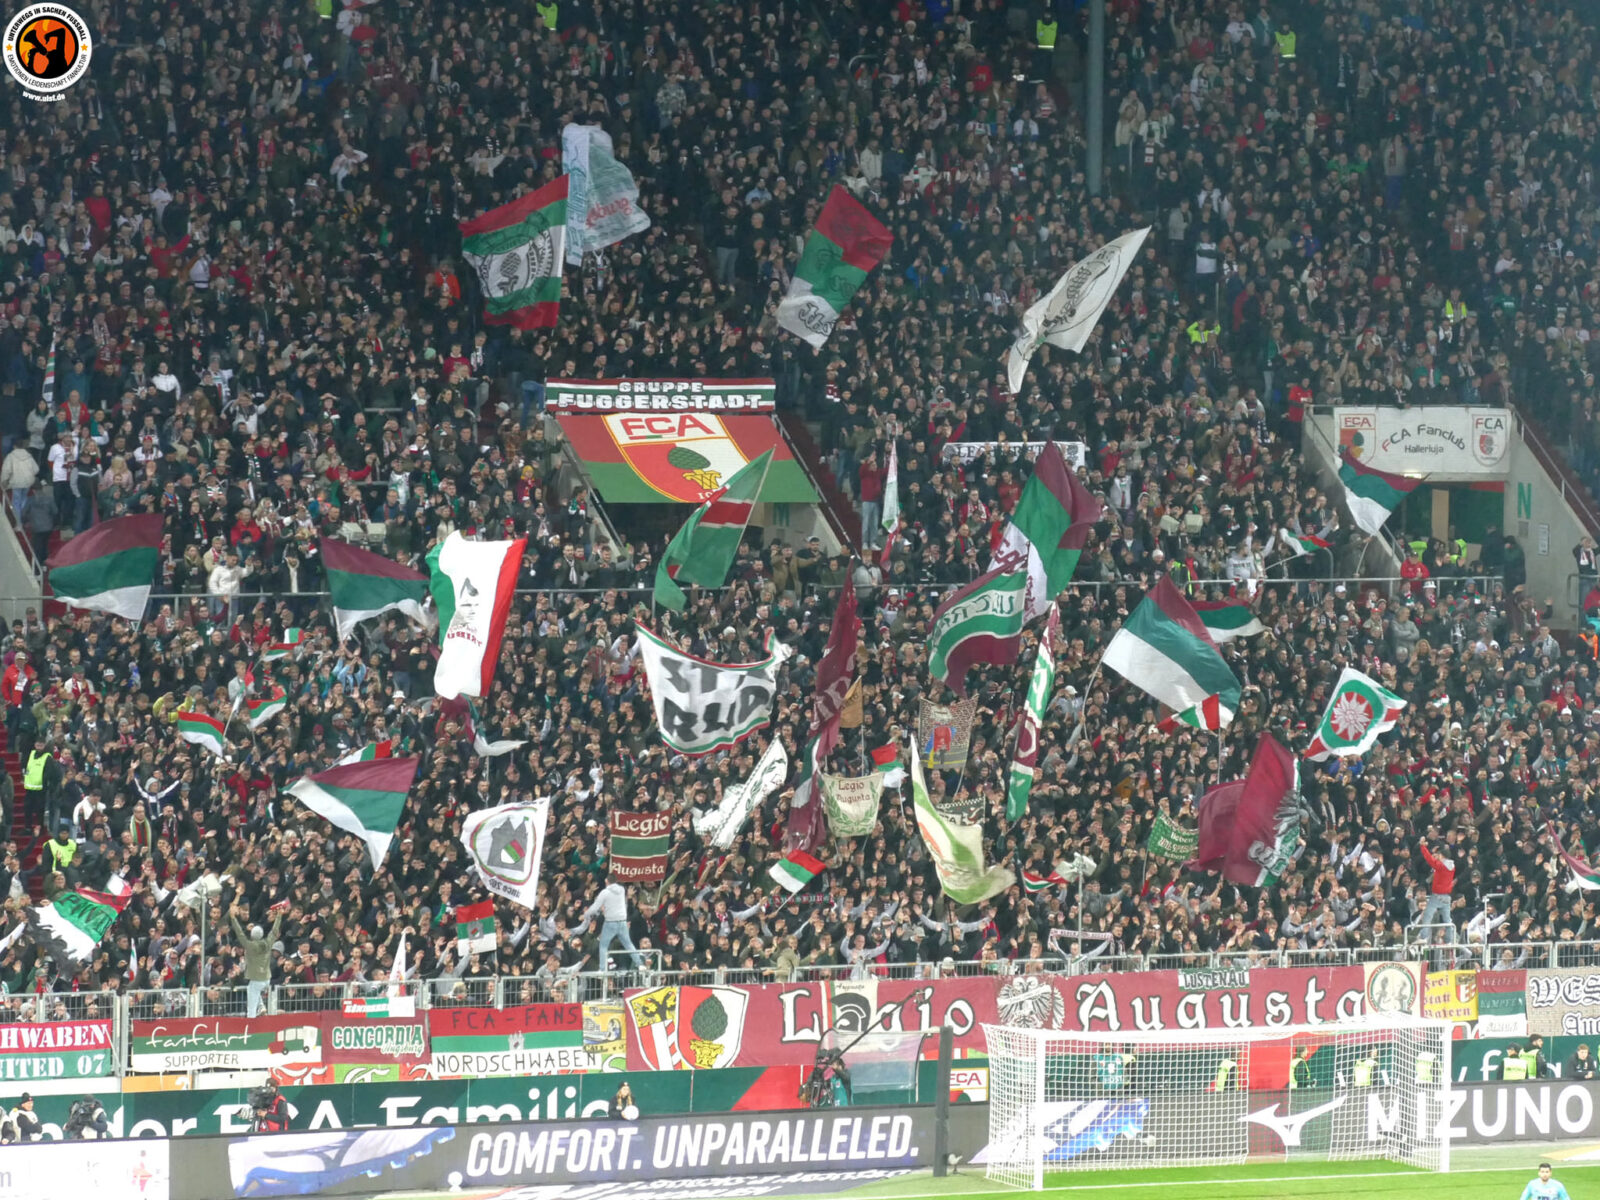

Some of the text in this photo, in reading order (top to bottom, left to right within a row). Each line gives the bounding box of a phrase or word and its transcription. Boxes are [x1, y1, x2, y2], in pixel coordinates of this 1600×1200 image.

[618, 381, 705, 394] GRUPPE
[557, 393, 763, 409] FUGGERSTADT
[620, 414, 716, 438] FCA
[1344, 416, 1372, 428] FCA
[1475, 417, 1504, 430] FCA
[1382, 424, 1466, 453] FCA Fanclub
[1517, 482, 1532, 520] N
[838, 778, 866, 794] Legio
[613, 811, 670, 837] Legio
[611, 862, 665, 878] Augusta
[1183, 968, 1248, 990] LUSTENAU
[452, 1011, 496, 1030] FCA
[525, 1005, 580, 1028] FANS
[145, 1021, 253, 1048] fanfahrt
[332, 1025, 425, 1050] CONCORDIA
[77, 1053, 106, 1075] 07
[164, 1053, 240, 1068] SUPPORTER
[436, 1049, 597, 1074] NORDSCHWABEN
[1368, 1084, 1594, 1142] MIZUNO
[466, 1114, 919, 1177] COMFORT. UNPARALLELED.
